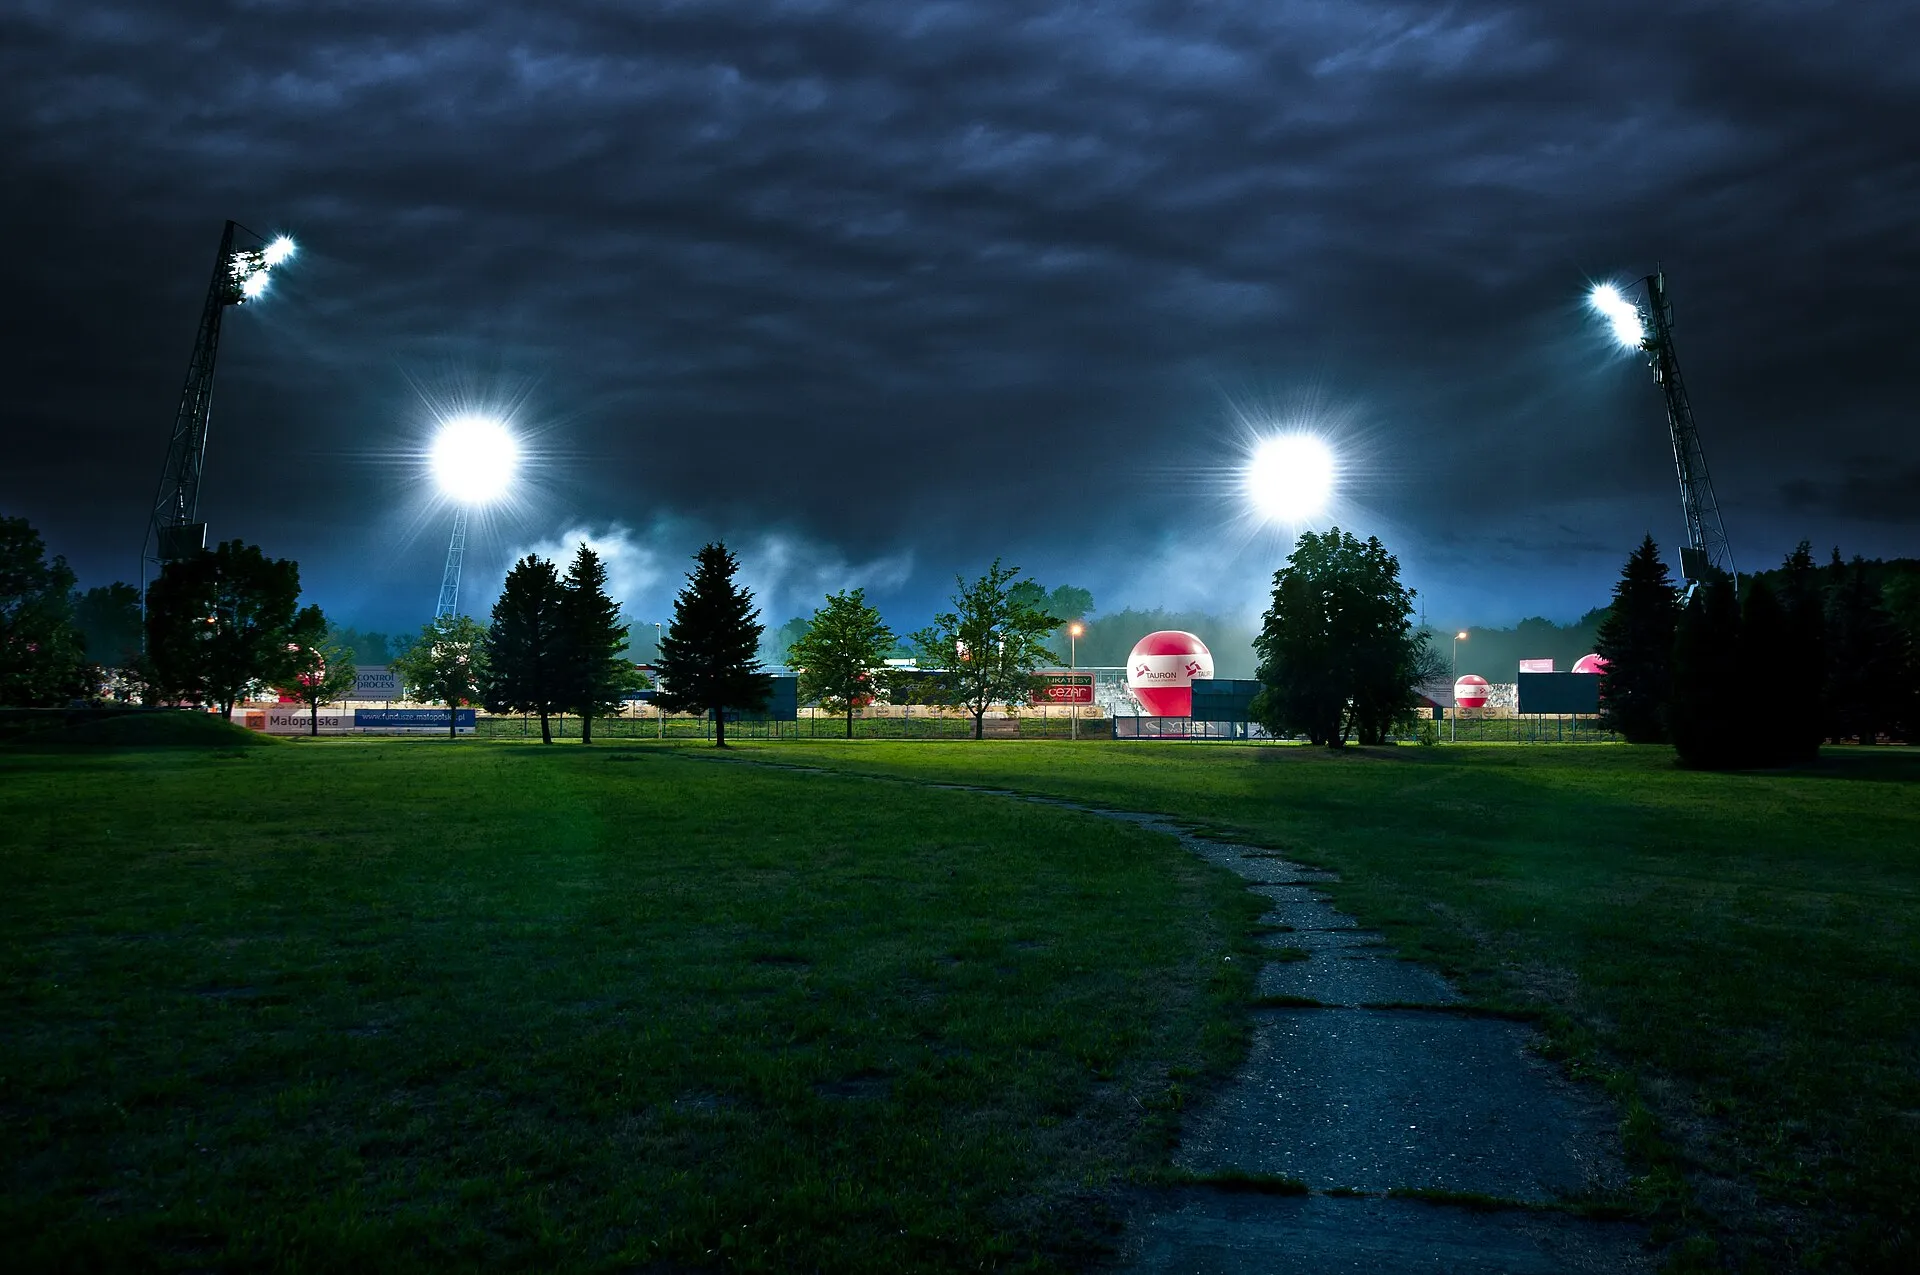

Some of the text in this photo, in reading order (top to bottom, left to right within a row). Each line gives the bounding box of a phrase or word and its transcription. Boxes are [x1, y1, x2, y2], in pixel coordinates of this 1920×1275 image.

[357, 681, 394, 691] PROCESS
[269, 716, 339, 728] Małoposka
[362, 713, 465, 723] www.fundusze.malopolsk.pl
